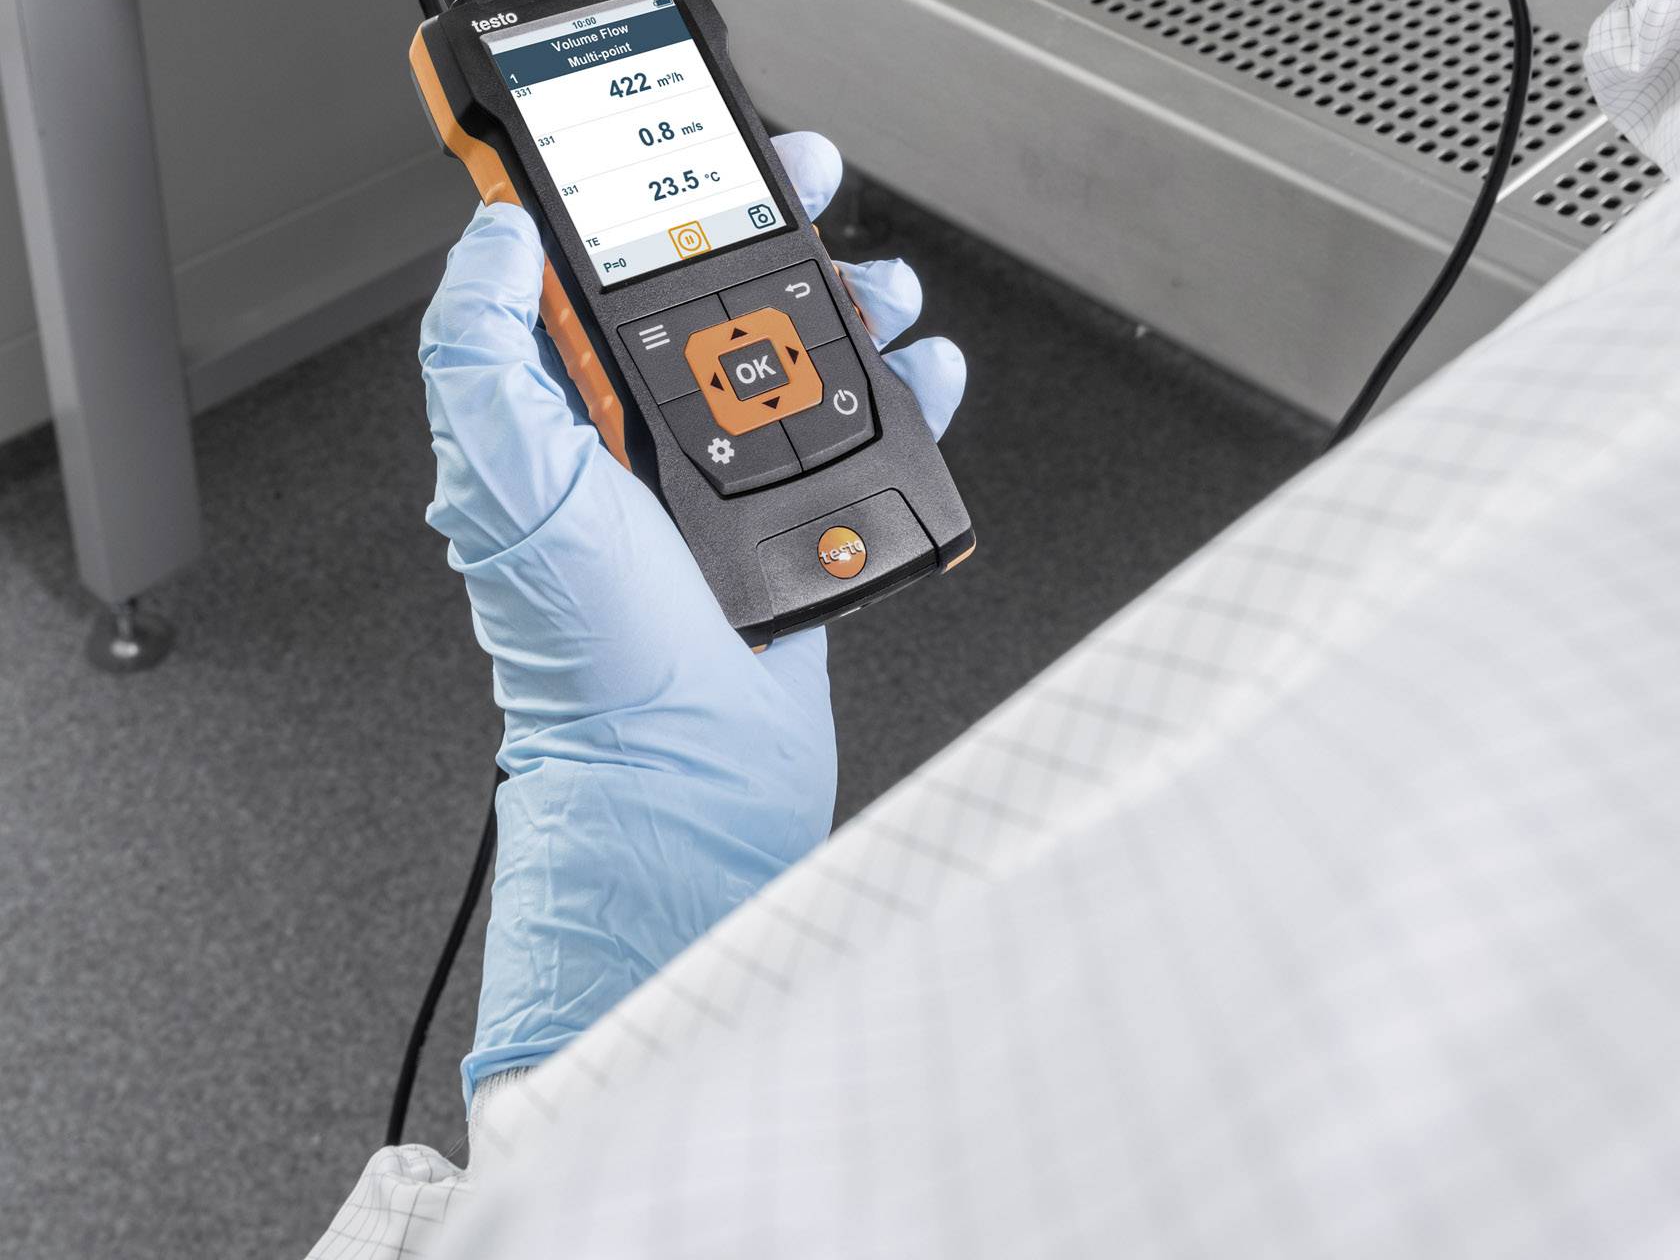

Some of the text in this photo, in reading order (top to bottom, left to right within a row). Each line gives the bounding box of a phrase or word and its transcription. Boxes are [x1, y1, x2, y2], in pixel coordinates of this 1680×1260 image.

[471, 10, 519, 34] testo
[572, 16, 597, 30] 10:00
[551, 23, 630, 53] Volume Flow
[567, 42, 632, 69] Multi-point
[510, 73, 519, 84] 1
[609, 72, 651, 98] 422
[514, 88, 532, 98] 331
[537, 135, 556, 147] 331
[638, 121, 704, 147] 0.8 m/s
[561, 184, 579, 197] 331
[648, 169, 721, 201] 23.5 °C
[585, 237, 601, 249] TE
[603, 257, 628, 273] P=0
[736, 355, 777, 384] OK
